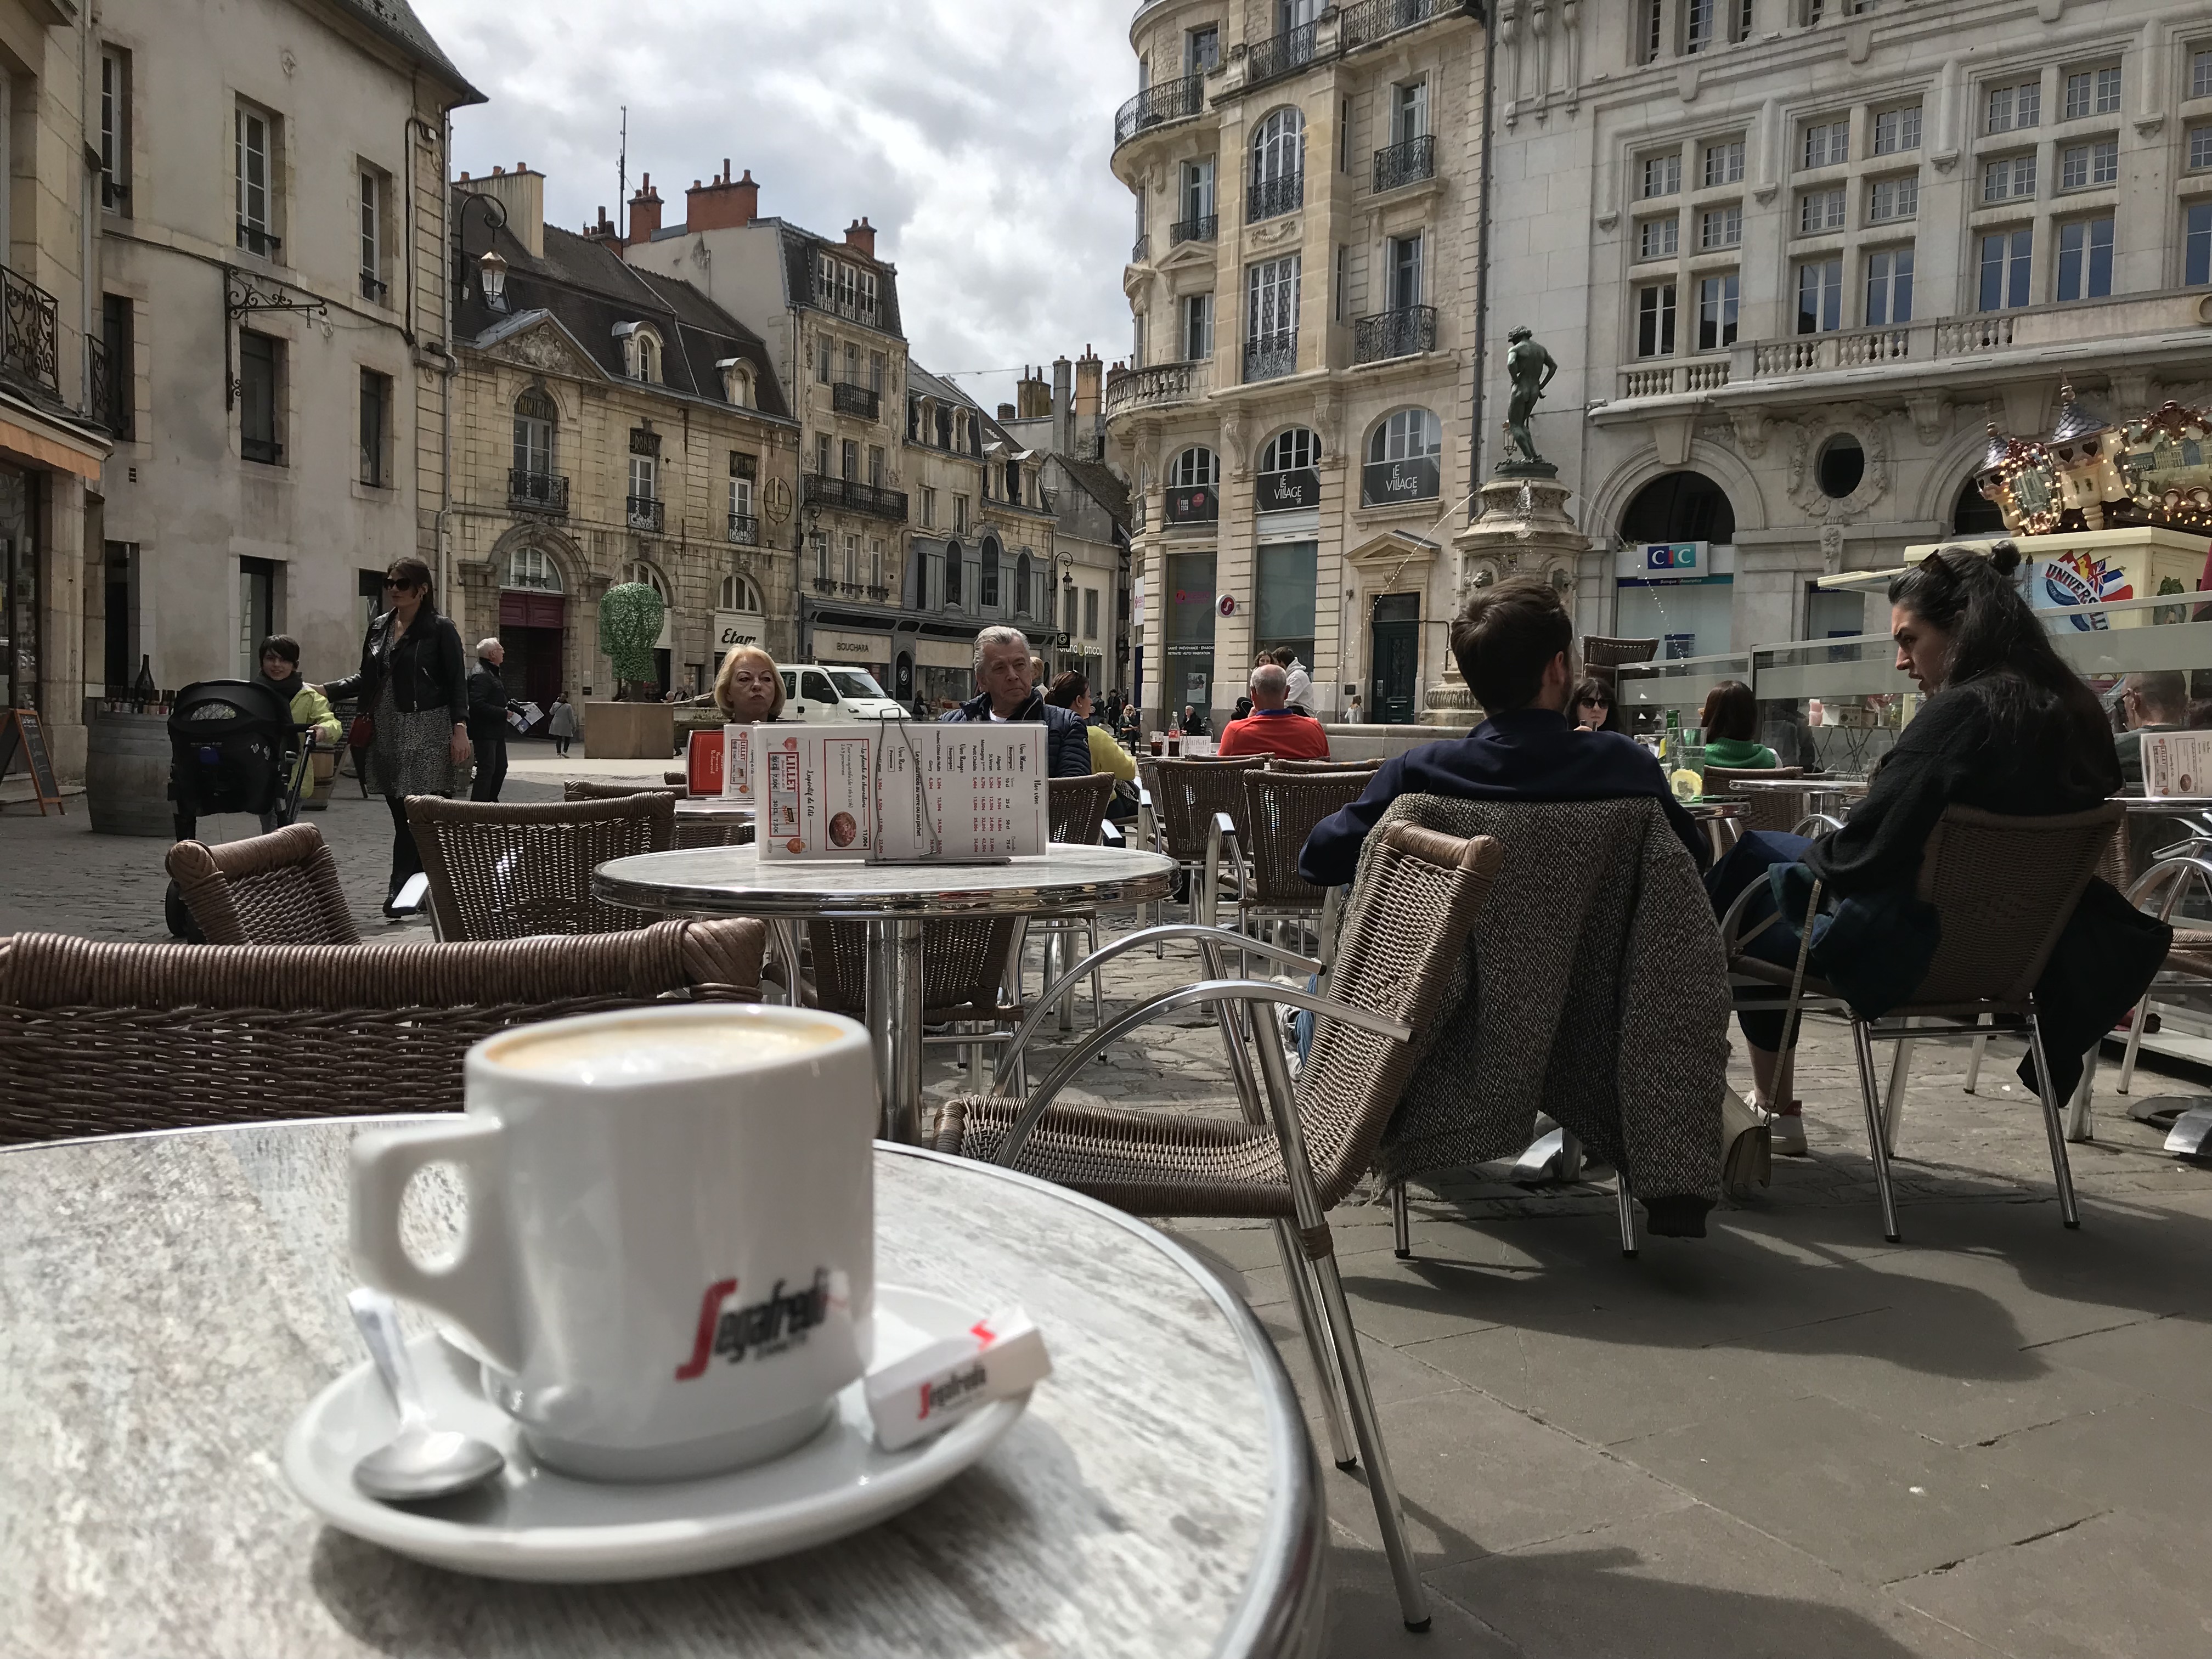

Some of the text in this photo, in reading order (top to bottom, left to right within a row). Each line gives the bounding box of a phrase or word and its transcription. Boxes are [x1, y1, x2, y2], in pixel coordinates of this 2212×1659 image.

[1393, 464, 1400, 479] LE
[1280, 474, 1286, 488] LE
[1386, 476, 1418, 492] VILLAGE
[1274, 486, 1302, 500] VILLAGE
[1652, 549, 1691, 565] CIC
[721, 628, 757, 645] Etam
[837, 642, 870, 652] BOUCHARA
[786, 755, 796, 792] LILLET
[805, 770, 814, 796] L'apéritif
